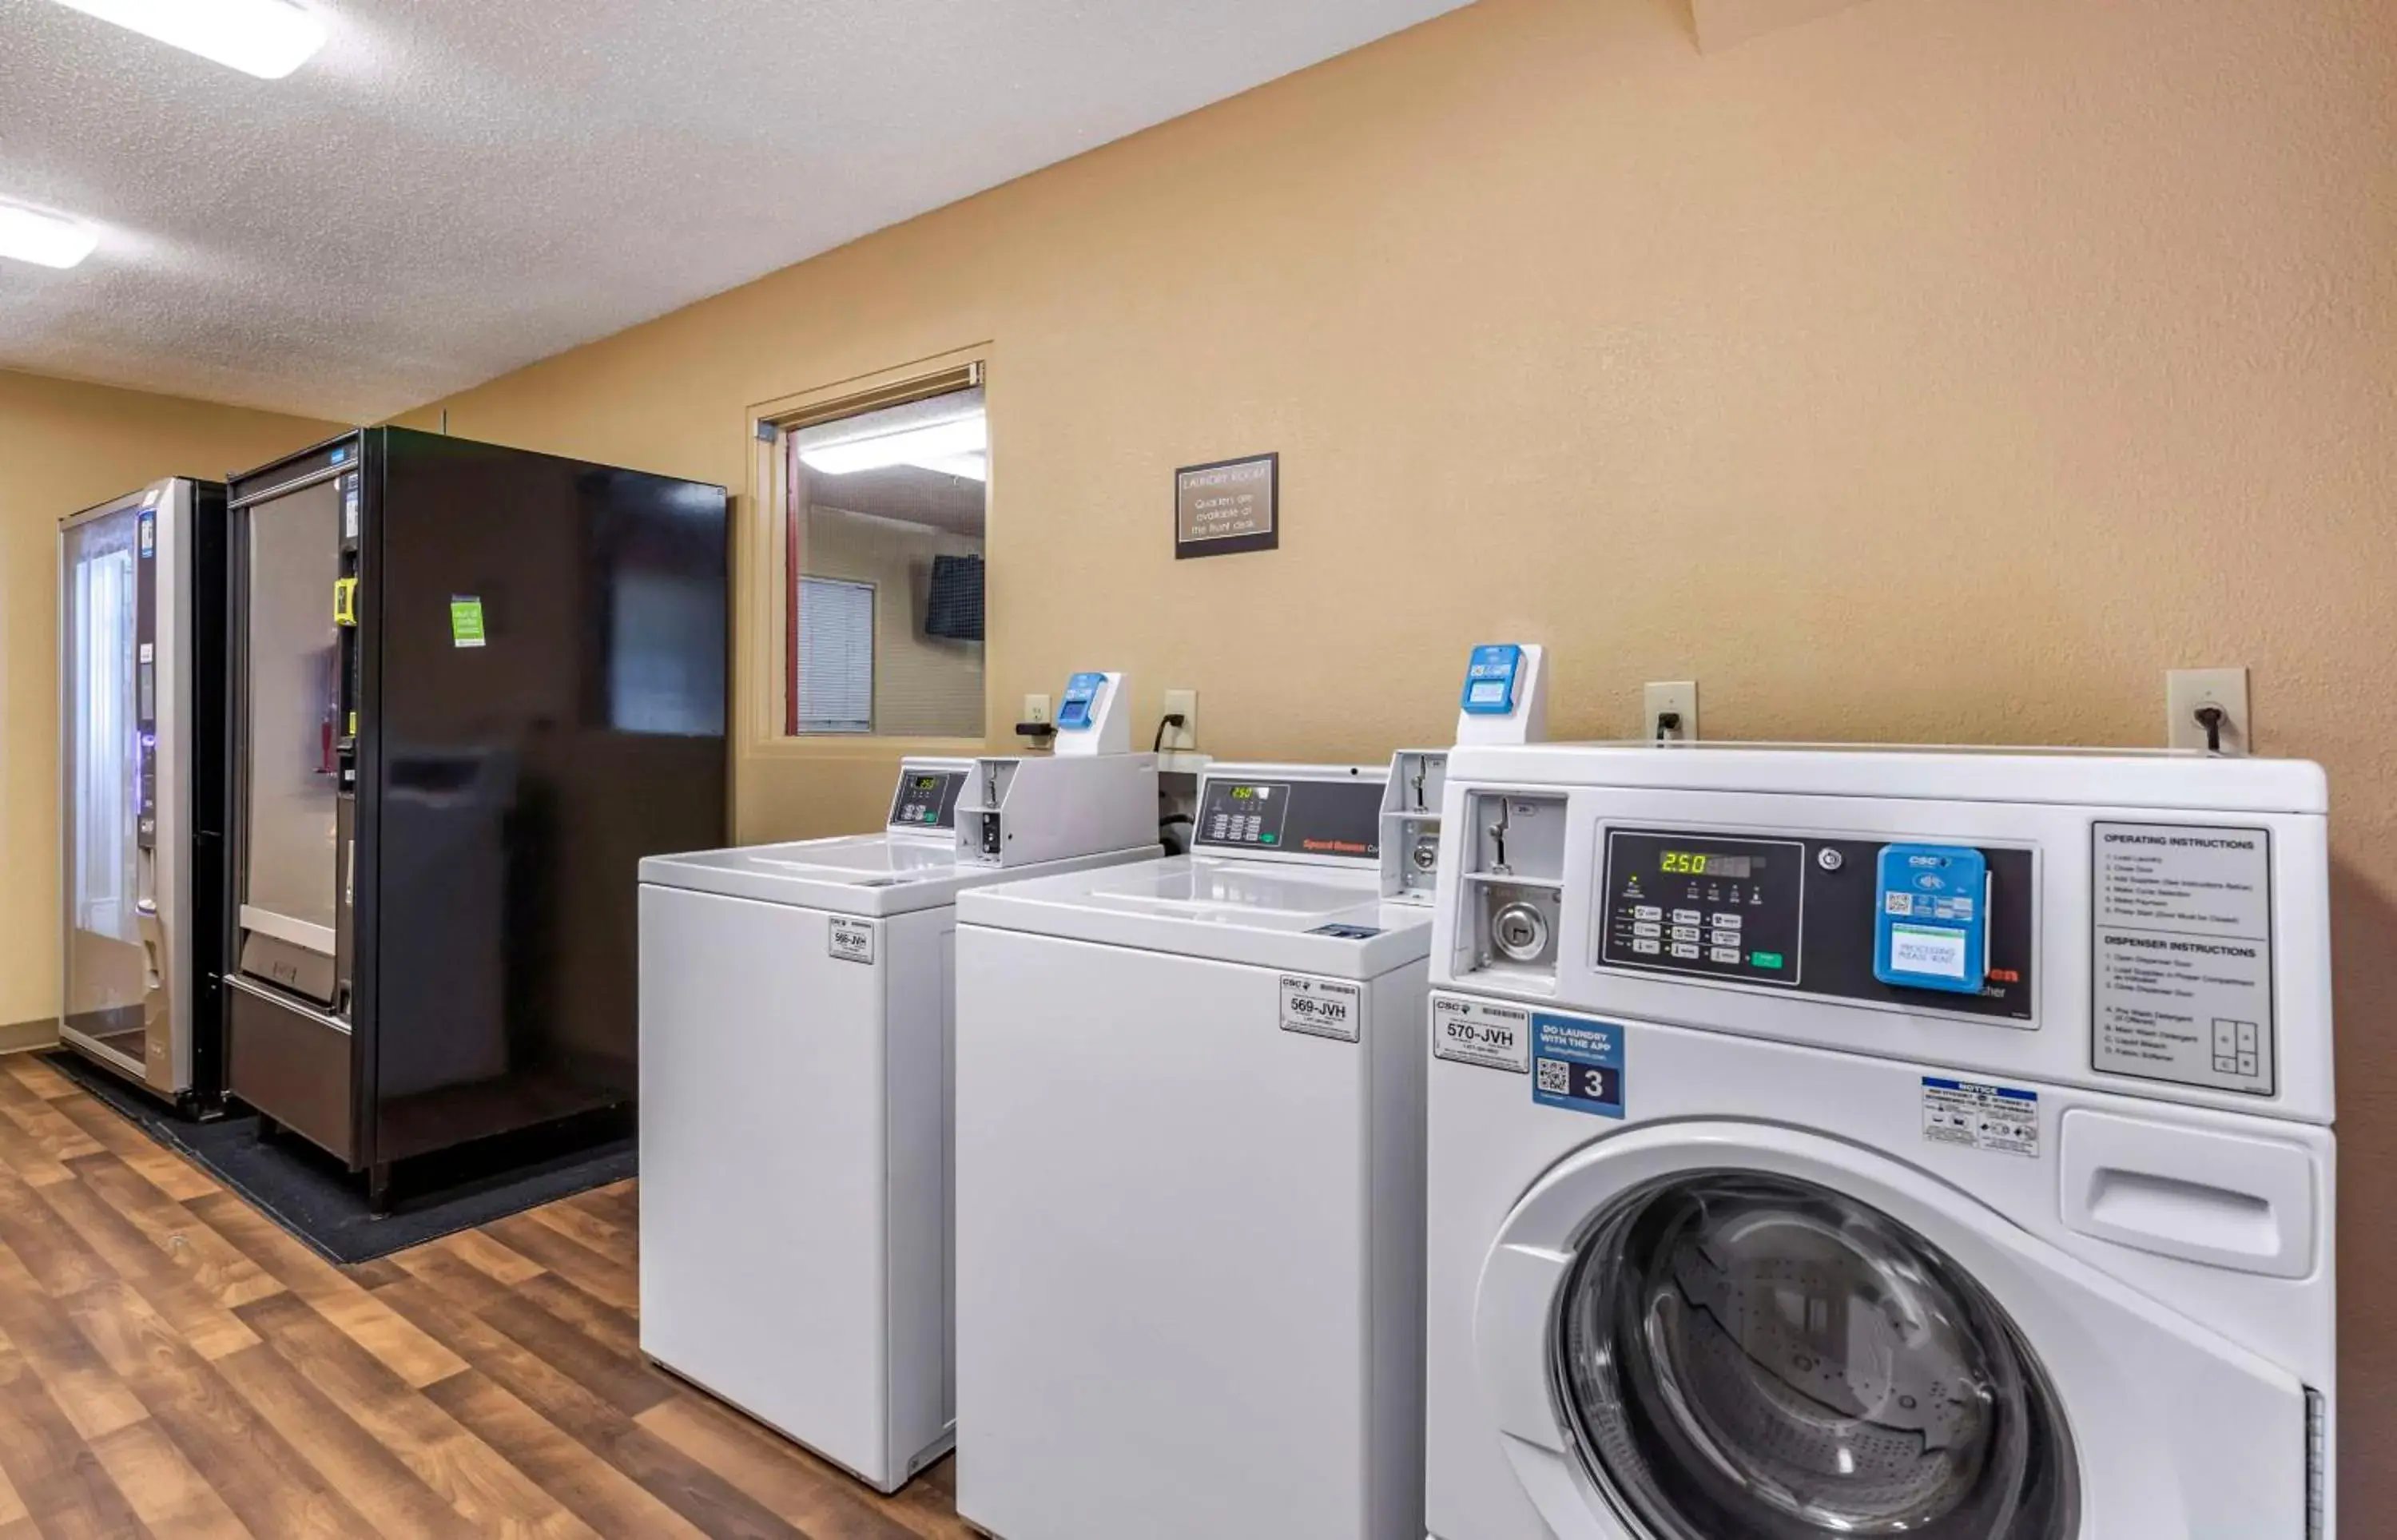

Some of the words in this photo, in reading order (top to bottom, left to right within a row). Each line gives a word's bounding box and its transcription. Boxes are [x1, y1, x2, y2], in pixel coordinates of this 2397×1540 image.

[1183, 474, 1228, 490] LAUNDRY
[1231, 467, 1265, 481] ROOM
[1195, 497, 1234, 510] Quarters
[1238, 494, 1254, 505] are
[1196, 509, 1238, 522] available
[2104, 834, 2167, 845] OPERATING
[2169, 836, 2255, 851] INSTRUCTIONS
[1661, 851, 1706, 874] 2.50
[2105, 935, 2167, 950] DISPENSER
[2169, 941, 2256, 958] INSTRUCTIONS
[1290, 998, 1346, 1018] 569-JVH
[1437, 1001, 1459, 1011] CSC
[1447, 1022, 1513, 1046] 570-JVH
[1540, 1033, 1567, 1046] WITH
[1568, 1038, 1589, 1049] THE
[1590, 1042, 1612, 1052] APP
[1543, 1025, 1559, 1034] DO
[1560, 1026, 1608, 1042] LAUNDRY
[1584, 1070, 1604, 1097] 3
